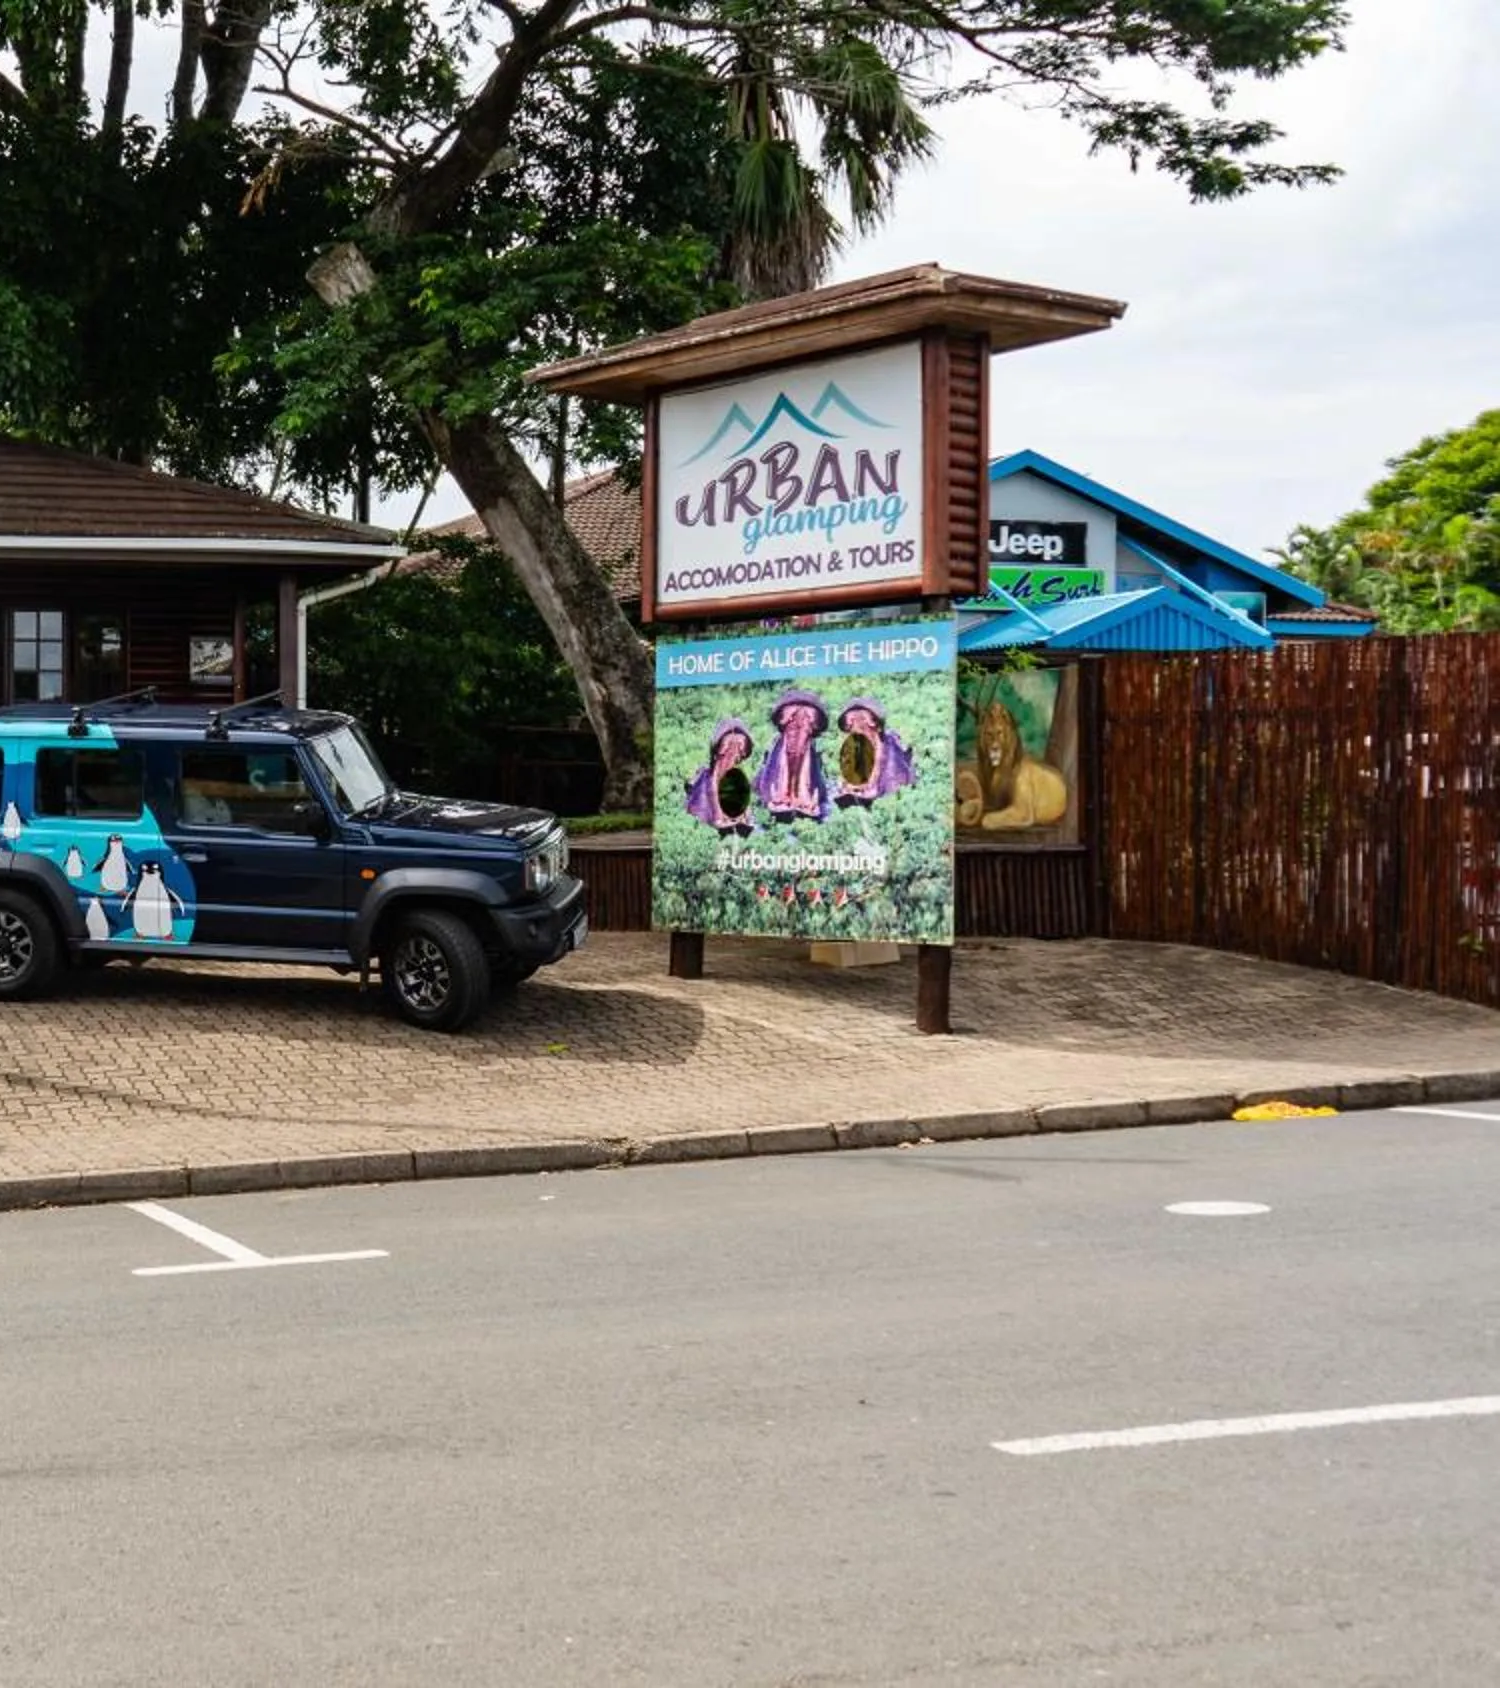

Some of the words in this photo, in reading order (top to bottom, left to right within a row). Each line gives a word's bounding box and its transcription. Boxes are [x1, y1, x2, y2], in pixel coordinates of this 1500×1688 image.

[742, 491, 908, 555] glamping
[989, 526, 1063, 560] Jeep
[664, 553, 822, 593] ACCOMODATION
[827, 551, 843, 573] &
[848, 540, 915, 569] TOURS
[668, 653, 724, 676] HOME
[729, 650, 755, 672] OF
[760, 645, 816, 670] ALICE
[823, 642, 862, 665] THE
[868, 636, 938, 662] HIPPO
[717, 849, 886, 875] #urbanglamping
